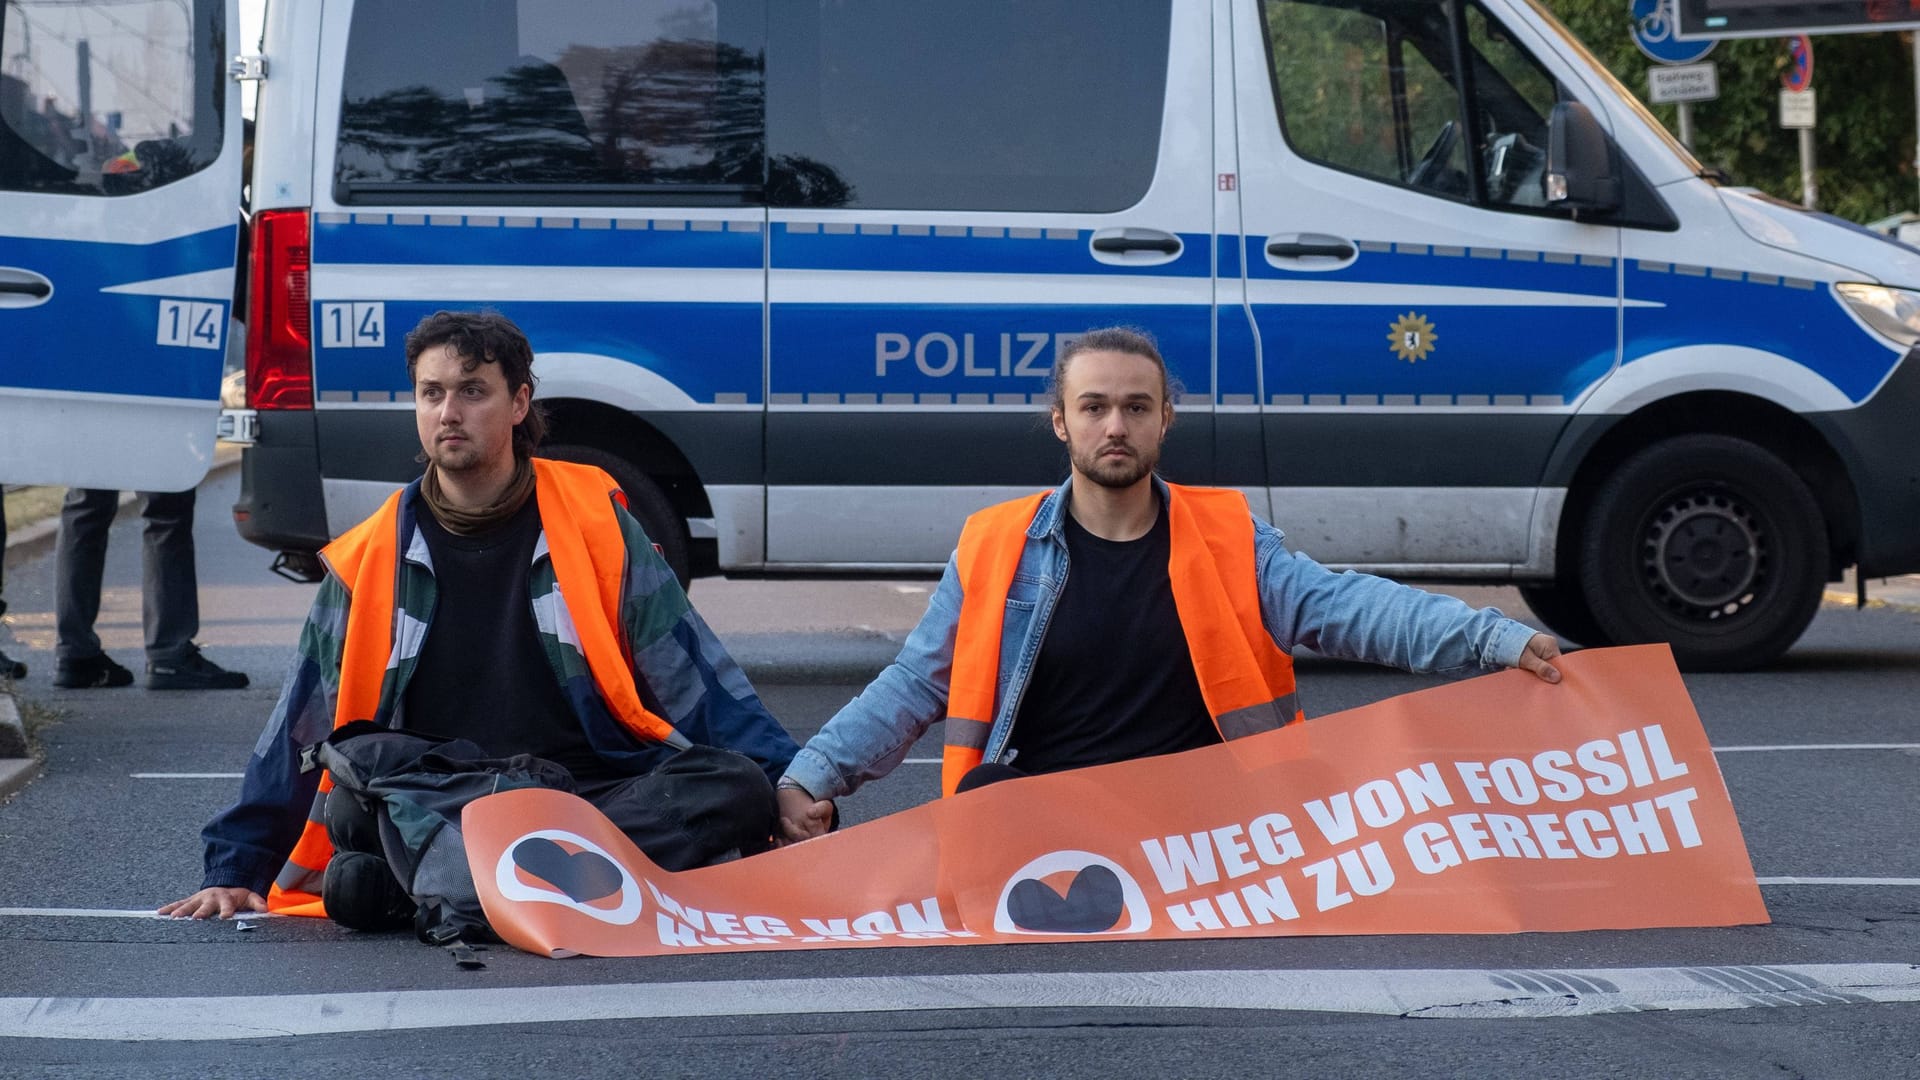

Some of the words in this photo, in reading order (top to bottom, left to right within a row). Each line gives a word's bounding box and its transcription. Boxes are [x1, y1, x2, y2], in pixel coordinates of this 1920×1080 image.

[167, 305, 217, 344] 14
[330, 306, 381, 343] 14
[875, 332, 1087, 377] POLIZE
[1140, 812, 1305, 894] WEG
[1302, 762, 1455, 845] VON
[1454, 723, 1690, 805] FOSSIL
[1166, 875, 1300, 932] HIN
[1301, 841, 1396, 913] ZU
[1402, 787, 1703, 875] GERECHT
[643, 876, 795, 936] WEG
[800, 896, 949, 936] VON
